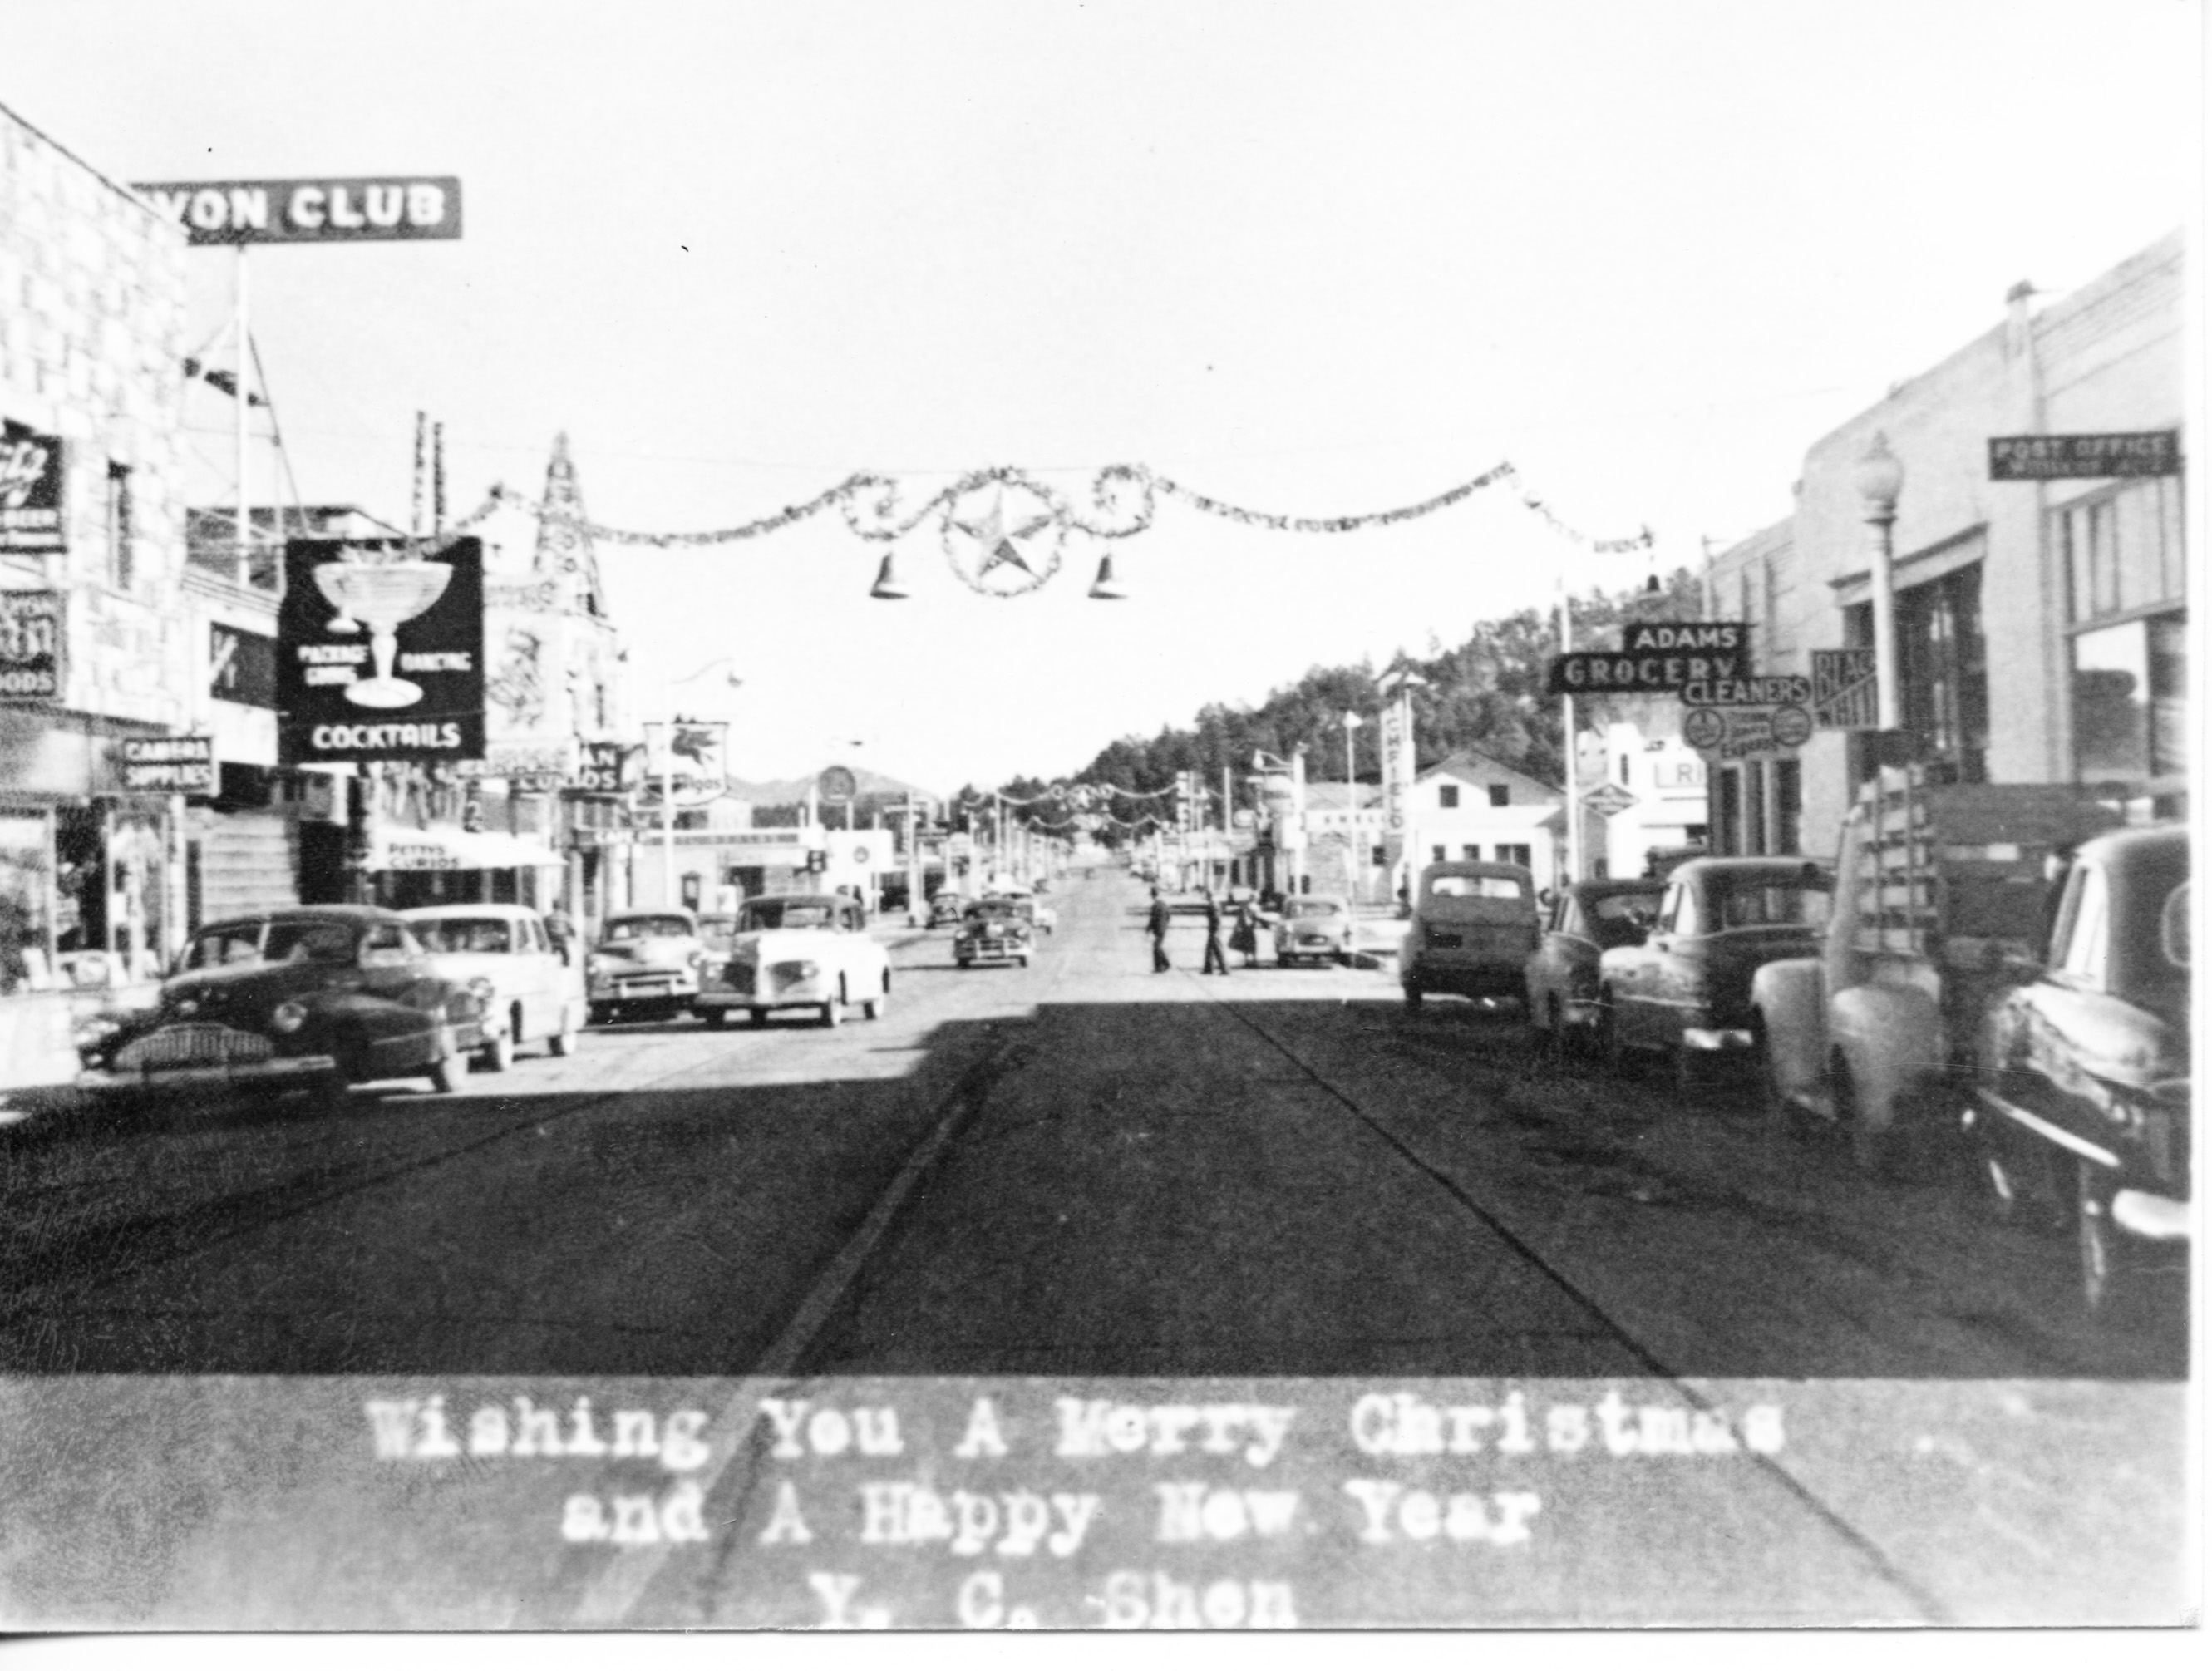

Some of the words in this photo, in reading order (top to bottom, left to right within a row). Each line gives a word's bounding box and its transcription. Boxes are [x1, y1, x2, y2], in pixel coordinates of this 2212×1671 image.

[290, 185, 445, 227] CLUB
[1997, 438, 2062, 457] POST
[1634, 628, 1738, 650] ADAMS
[1565, 657, 1737, 685] GROCERY
[1685, 678, 1810, 705] CLEANERS
[312, 723, 461, 749] COCKTAILS
